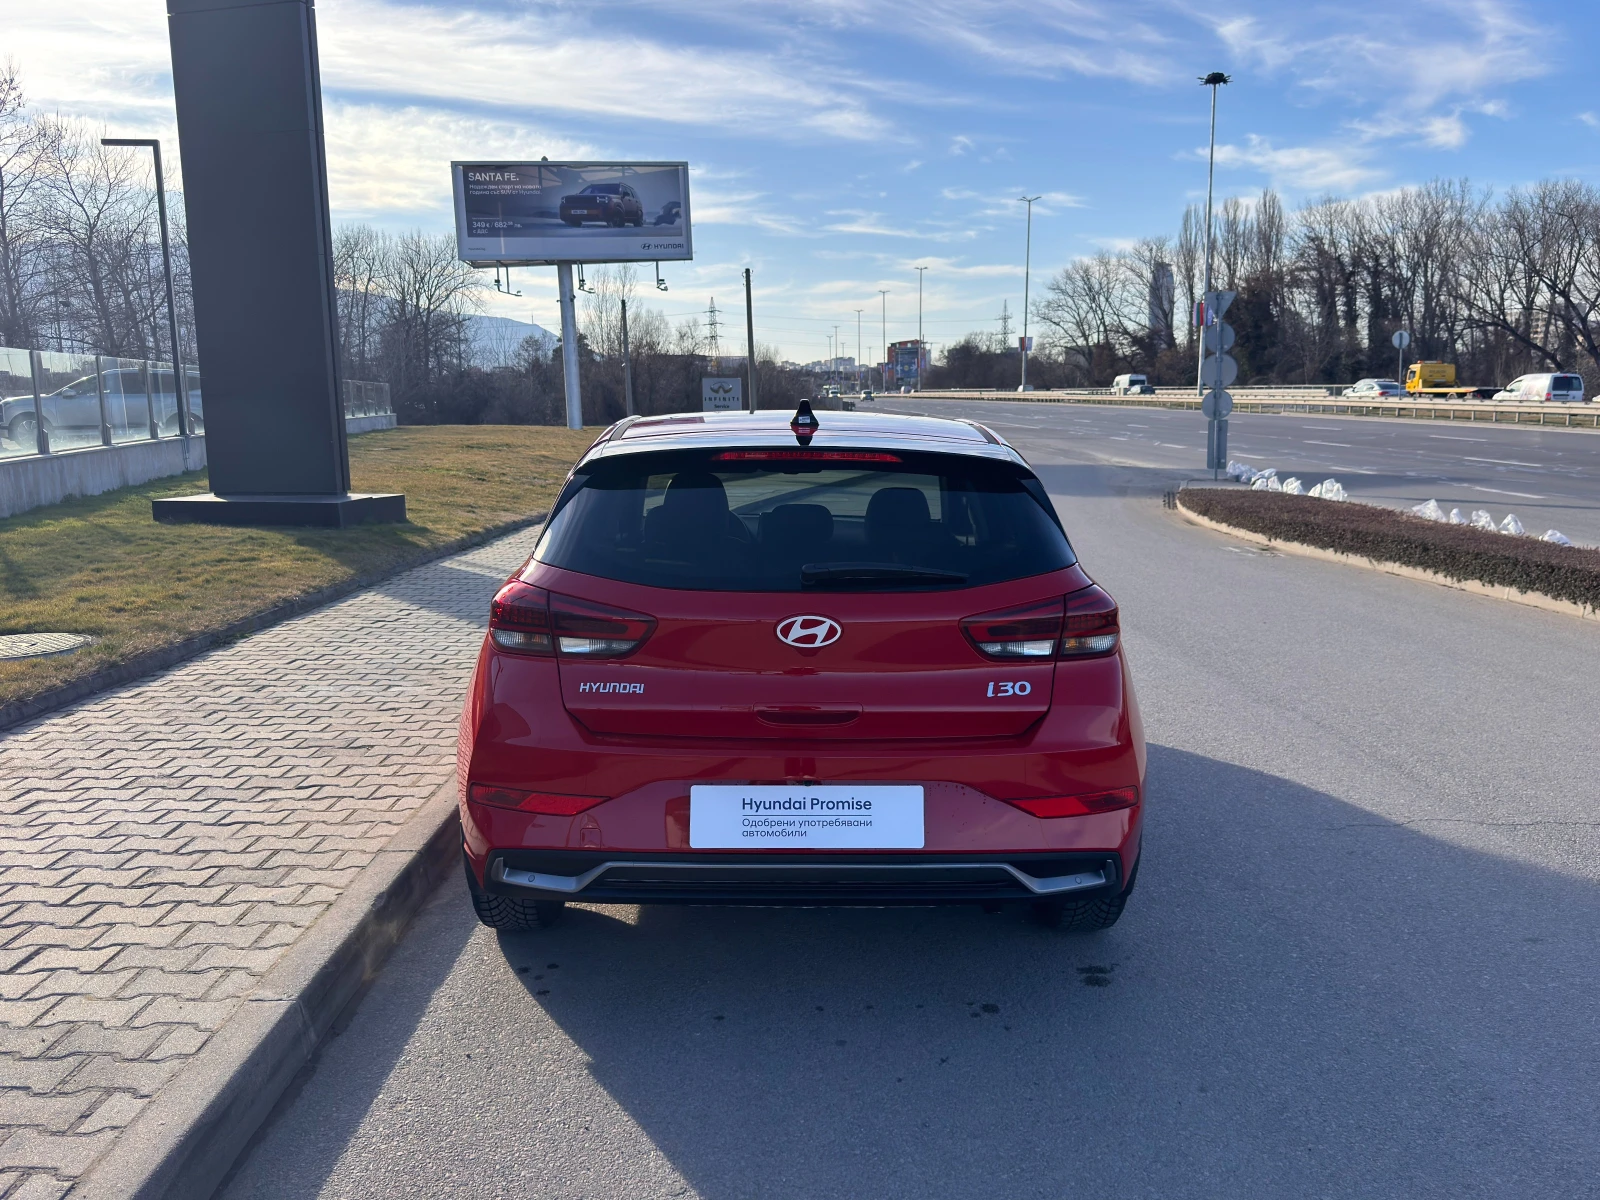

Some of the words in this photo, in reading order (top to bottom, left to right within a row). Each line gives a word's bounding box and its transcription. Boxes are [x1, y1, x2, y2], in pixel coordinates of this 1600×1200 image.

[468, 172, 503, 181] SANTA
[504, 172, 519, 181] FE.
[579, 682, 645, 695] HYUNDAI
[742, 797, 806, 813] Hyundai
[810, 796, 872, 810] Promise
[742, 817, 796, 829] Одобрени
[798, 818, 873, 829] употребявани
[742, 828, 807, 837] автомобили
